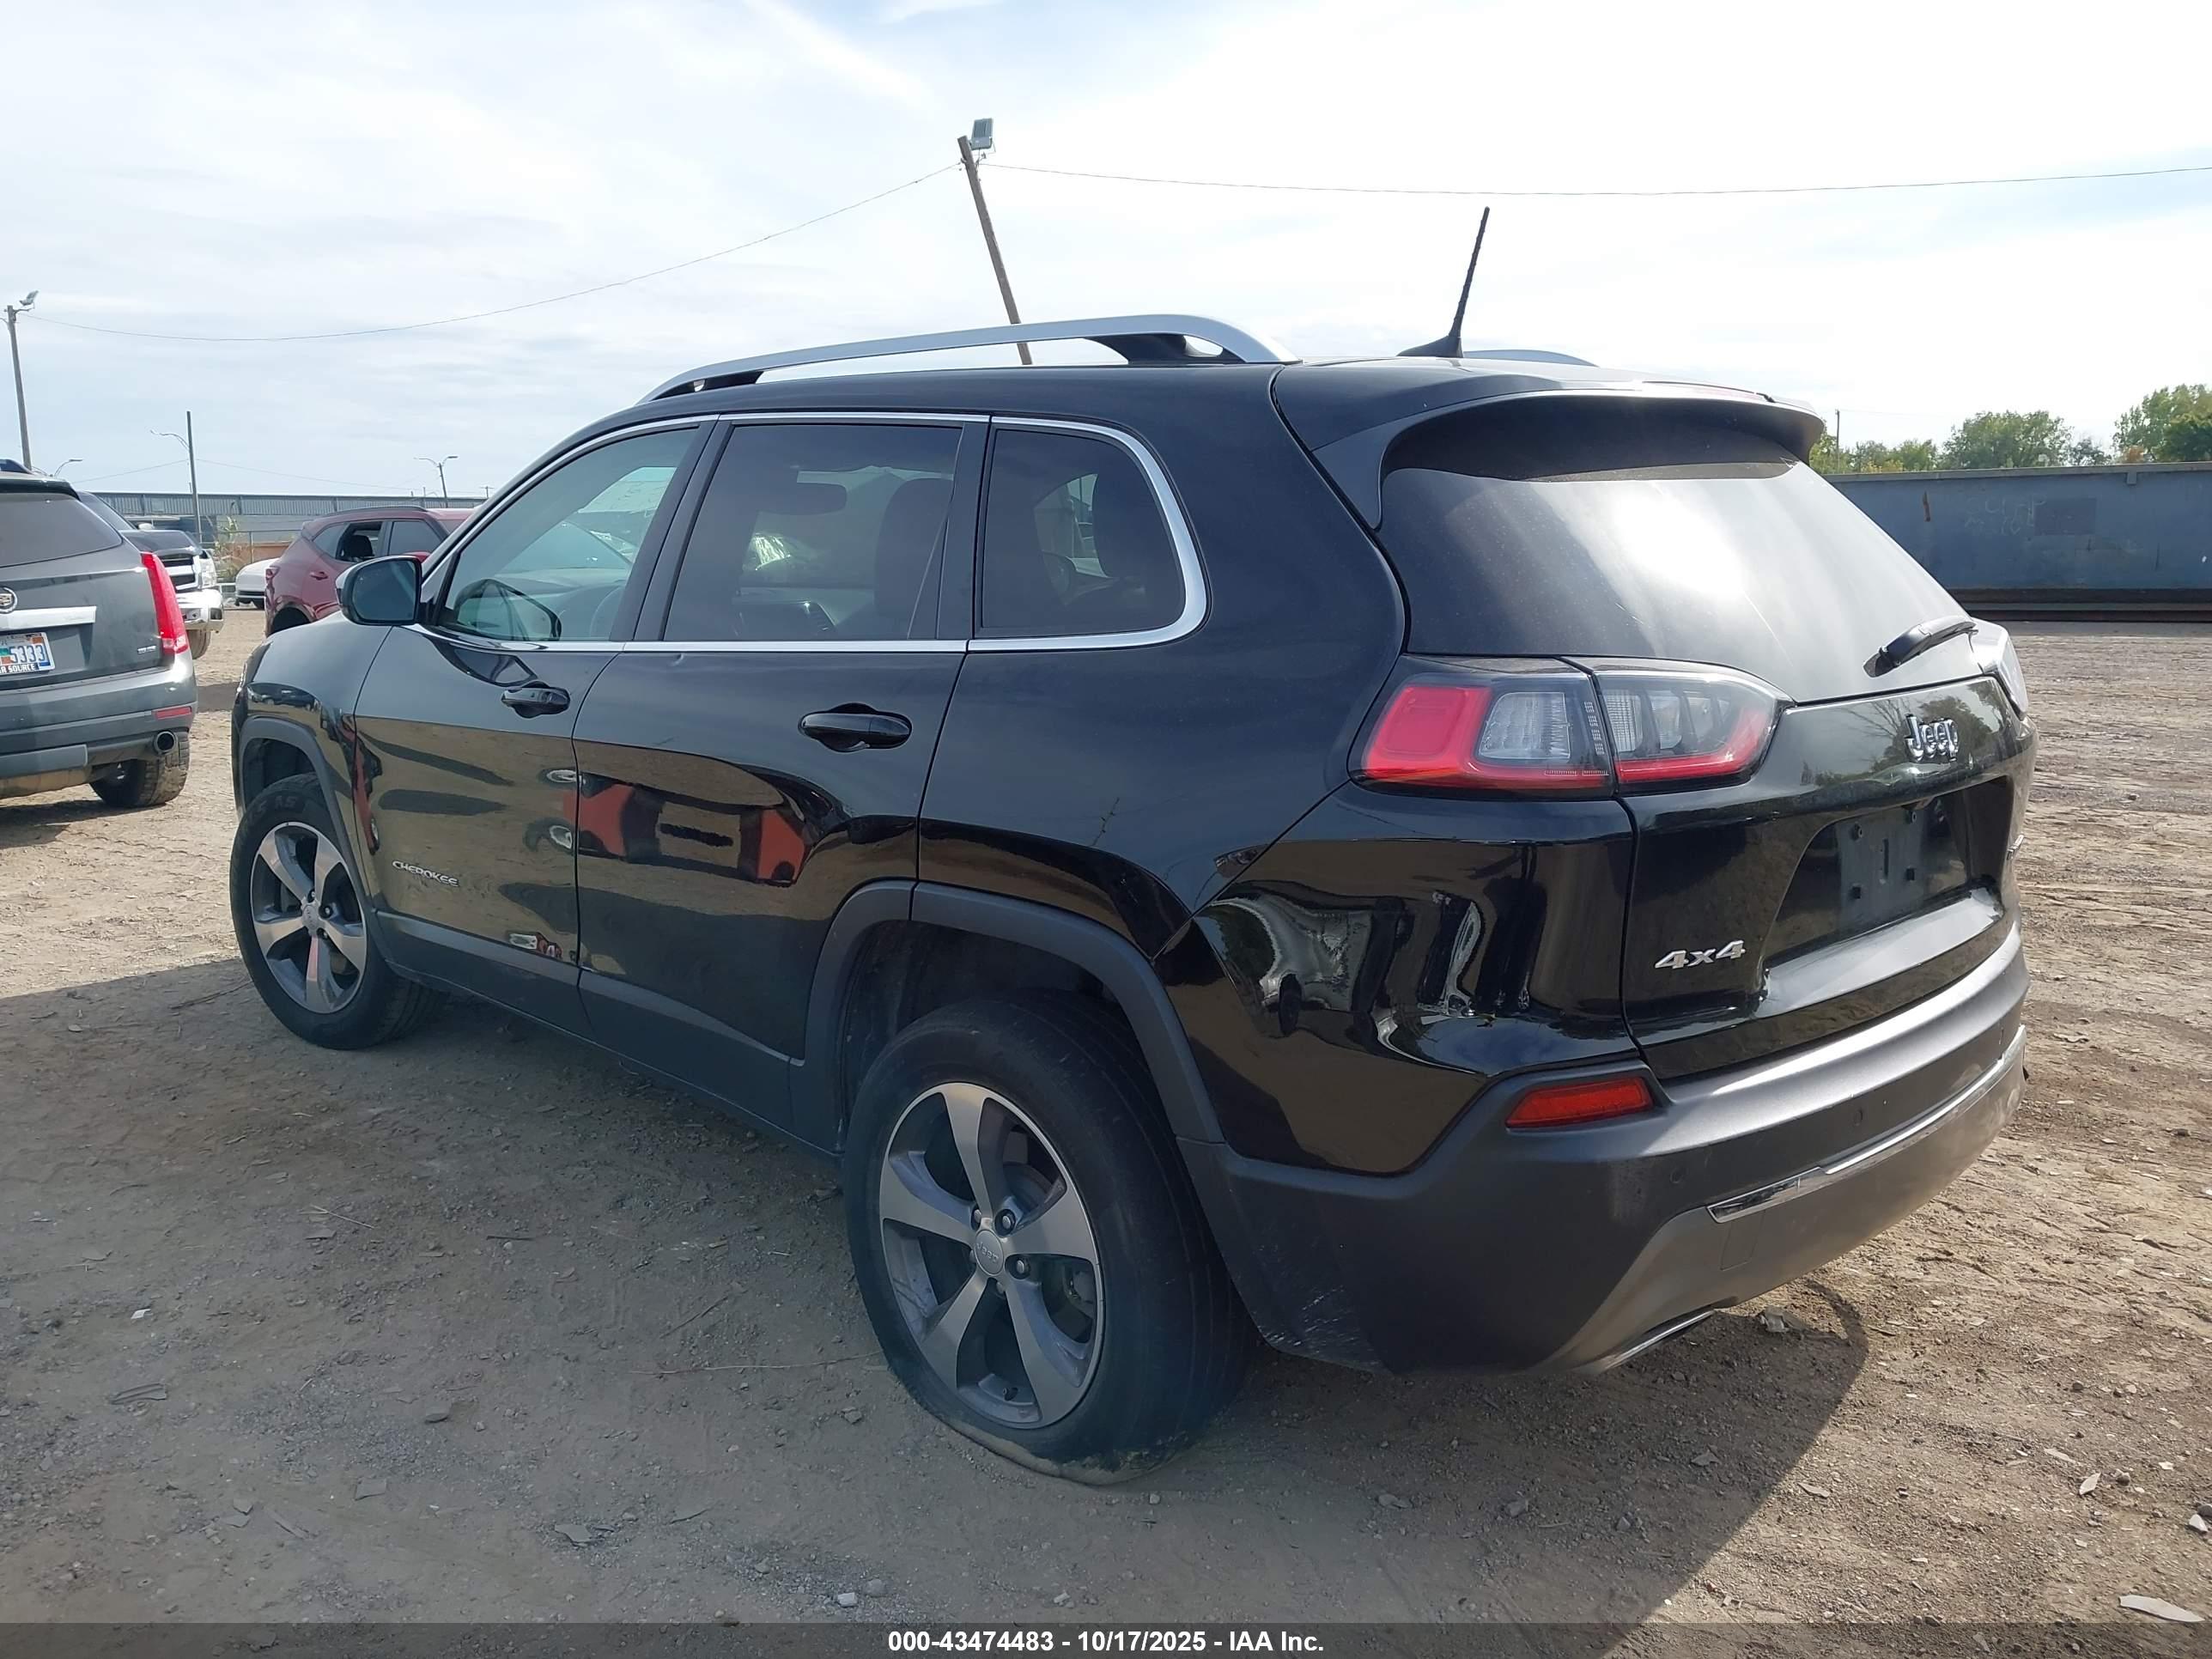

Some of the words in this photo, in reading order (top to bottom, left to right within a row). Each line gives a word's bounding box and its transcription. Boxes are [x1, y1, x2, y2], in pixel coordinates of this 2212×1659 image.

[9, 644, 46, 664] 5333
[8, 663, 36, 673] SOURCE
[1905, 714, 1959, 762] Jeep
[392, 860, 460, 887] CHEROKEE
[1655, 939, 1746, 969] 4x4
[976, 1241, 1000, 1263] Jeep
